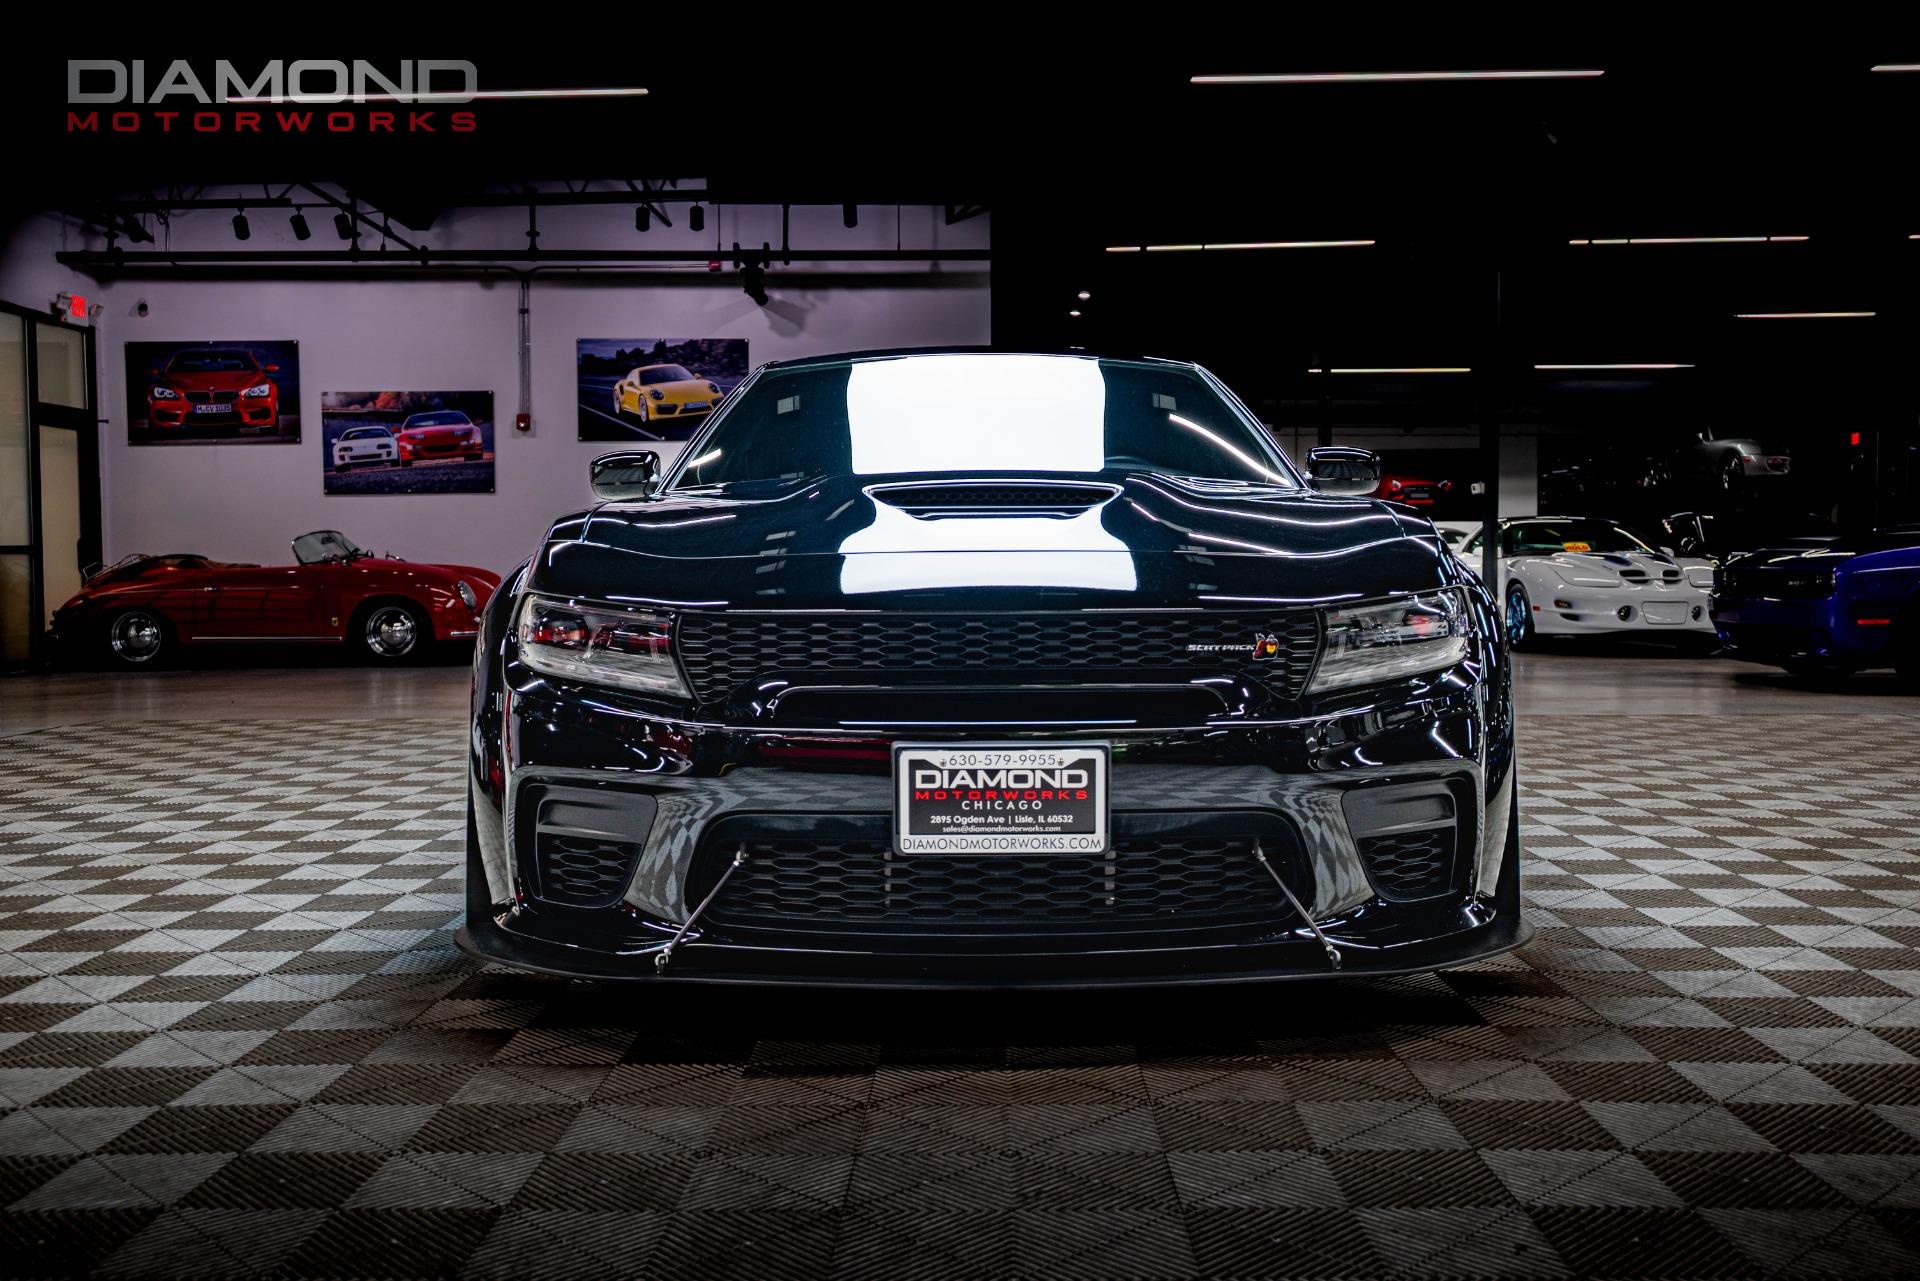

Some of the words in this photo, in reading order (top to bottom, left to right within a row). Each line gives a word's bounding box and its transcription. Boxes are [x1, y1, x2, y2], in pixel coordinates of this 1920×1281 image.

[949, 754, 1056, 767] 630-579-9955
[915, 769, 1089, 789] DIAMOND
[915, 790, 1088, 800] MOTORWORKS
[961, 800, 1043, 810] CHICAGO
[930, 815, 952, 824] 2895
[953, 815, 985, 826] Ogden
[986, 815, 1005, 824] Ave
[1015, 815, 1036, 825] Lisle,
[1038, 815, 1046, 824] IL
[1047, 814, 1074, 824] 60532
[942, 824, 1061, 834] sales@diamondmotorworks.com
[903, 837, 1102, 850] DIAMONDMOTORWORKS.COM
